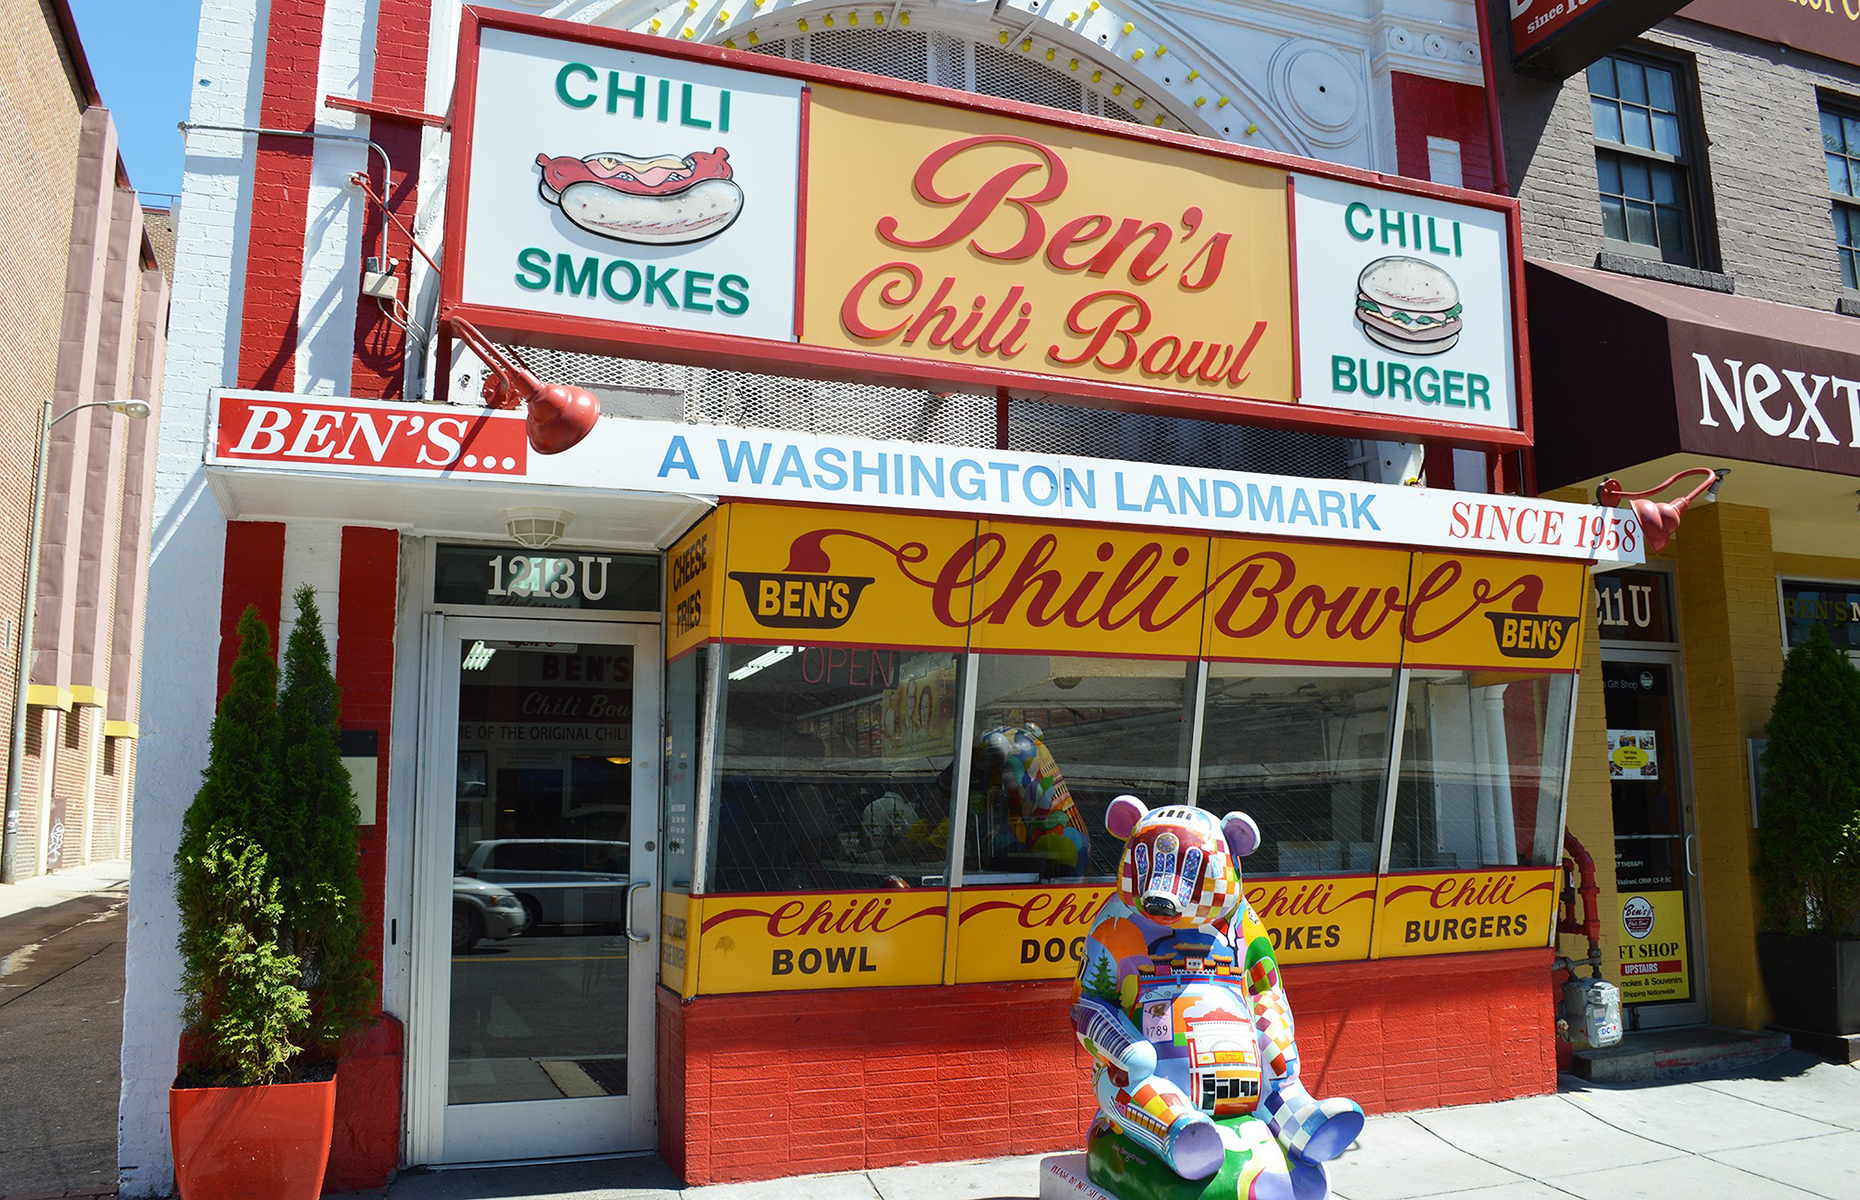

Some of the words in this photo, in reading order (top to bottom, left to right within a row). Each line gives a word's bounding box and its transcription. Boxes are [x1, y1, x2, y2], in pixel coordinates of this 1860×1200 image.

[1527, 3, 1564, 34] since
[555, 62, 731, 133] CHILI
[878, 134, 1232, 289] Ben's
[1345, 202, 1462, 257] CHILI
[514, 247, 750, 316] SMOKES
[842, 261, 1032, 356] Chili
[1049, 290, 1267, 384] Bowl
[1331, 354, 1491, 410] BURGER
[229, 405, 516, 471] BEN'S...
[657, 435, 700, 479] A
[717, 439, 1096, 509] WASHINGTON
[1115, 471, 1381, 531] LANDMARK
[1448, 501, 1564, 546] SINCE
[1574, 515, 1637, 553] 1958
[488, 555, 612, 601] 1213U
[673, 533, 707, 592] CHEESE
[757, 579, 850, 619] BEN'S
[931, 533, 1192, 633] Chili
[1214, 551, 1462, 643] Bowl
[676, 589, 701, 638] FRIES
[1783, 598, 1848, 621] BEN'S
[1501, 618, 1563, 651] BEN'S
[542, 654, 631, 683] BEN'S
[803, 646, 893, 688] OPEN
[1608, 680, 1620, 689] Gift
[1620, 680, 1638, 691] Shop
[522, 691, 581, 717] Chili
[477, 726, 495, 739] OF
[499, 726, 525, 740] THE
[530, 726, 592, 740] ORIGINAL
[595, 727, 628, 741] CHILI
[1428, 875, 1516, 909] Chili
[767, 898, 893, 938] Chili
[1624, 903, 1648, 917] Ben's
[1404, 913, 1528, 944] BURGERS
[771, 946, 877, 976] BOWL
[1619, 945, 1636, 960] FT
[1639, 942, 1679, 958] SHOP
[1621, 979, 1643, 988] mokes
[1644, 978, 1650, 986] &
[1651, 976, 1683, 986] Souvenirs
[1624, 963, 1658, 975] UPSTAIRS
[1623, 989, 1647, 999] Shipping
[1647, 988, 1676, 997] Nationwide
[1146, 1024, 1168, 1038] 1789
[1050, 1165, 1069, 1180] PLEASE
[1069, 1176, 1077, 1185] DO
[1076, 1180, 1090, 1192] NOT
